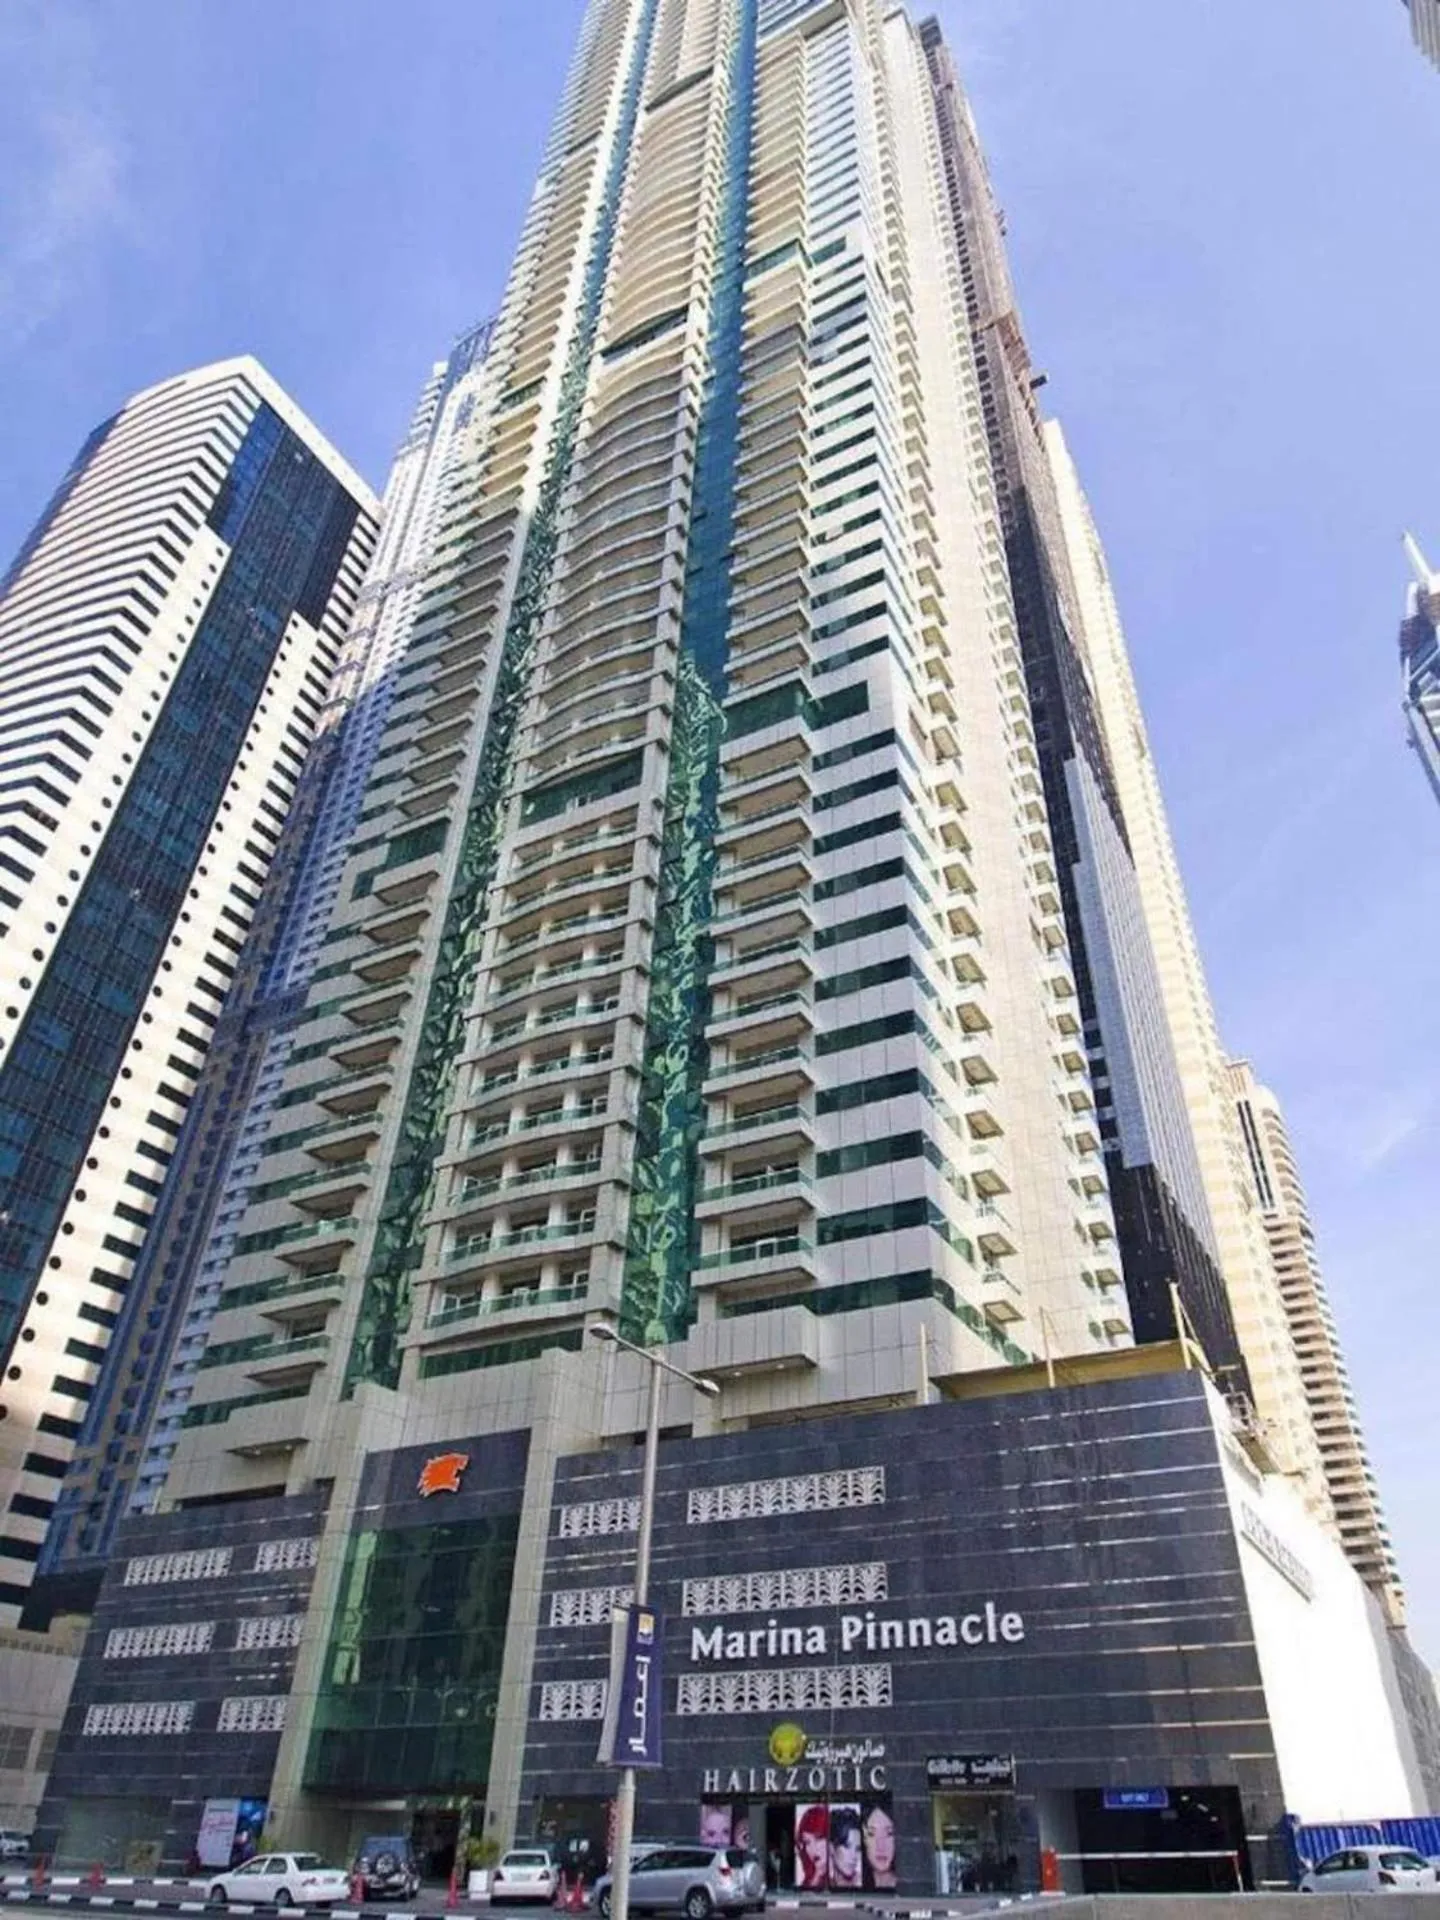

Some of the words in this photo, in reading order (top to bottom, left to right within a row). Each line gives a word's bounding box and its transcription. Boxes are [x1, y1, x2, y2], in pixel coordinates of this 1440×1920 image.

[690, 1618, 827, 1661] Marina
[841, 1601, 1025, 1651] Pinnacle
[703, 1765, 887, 1793] HAIRZOTIC
